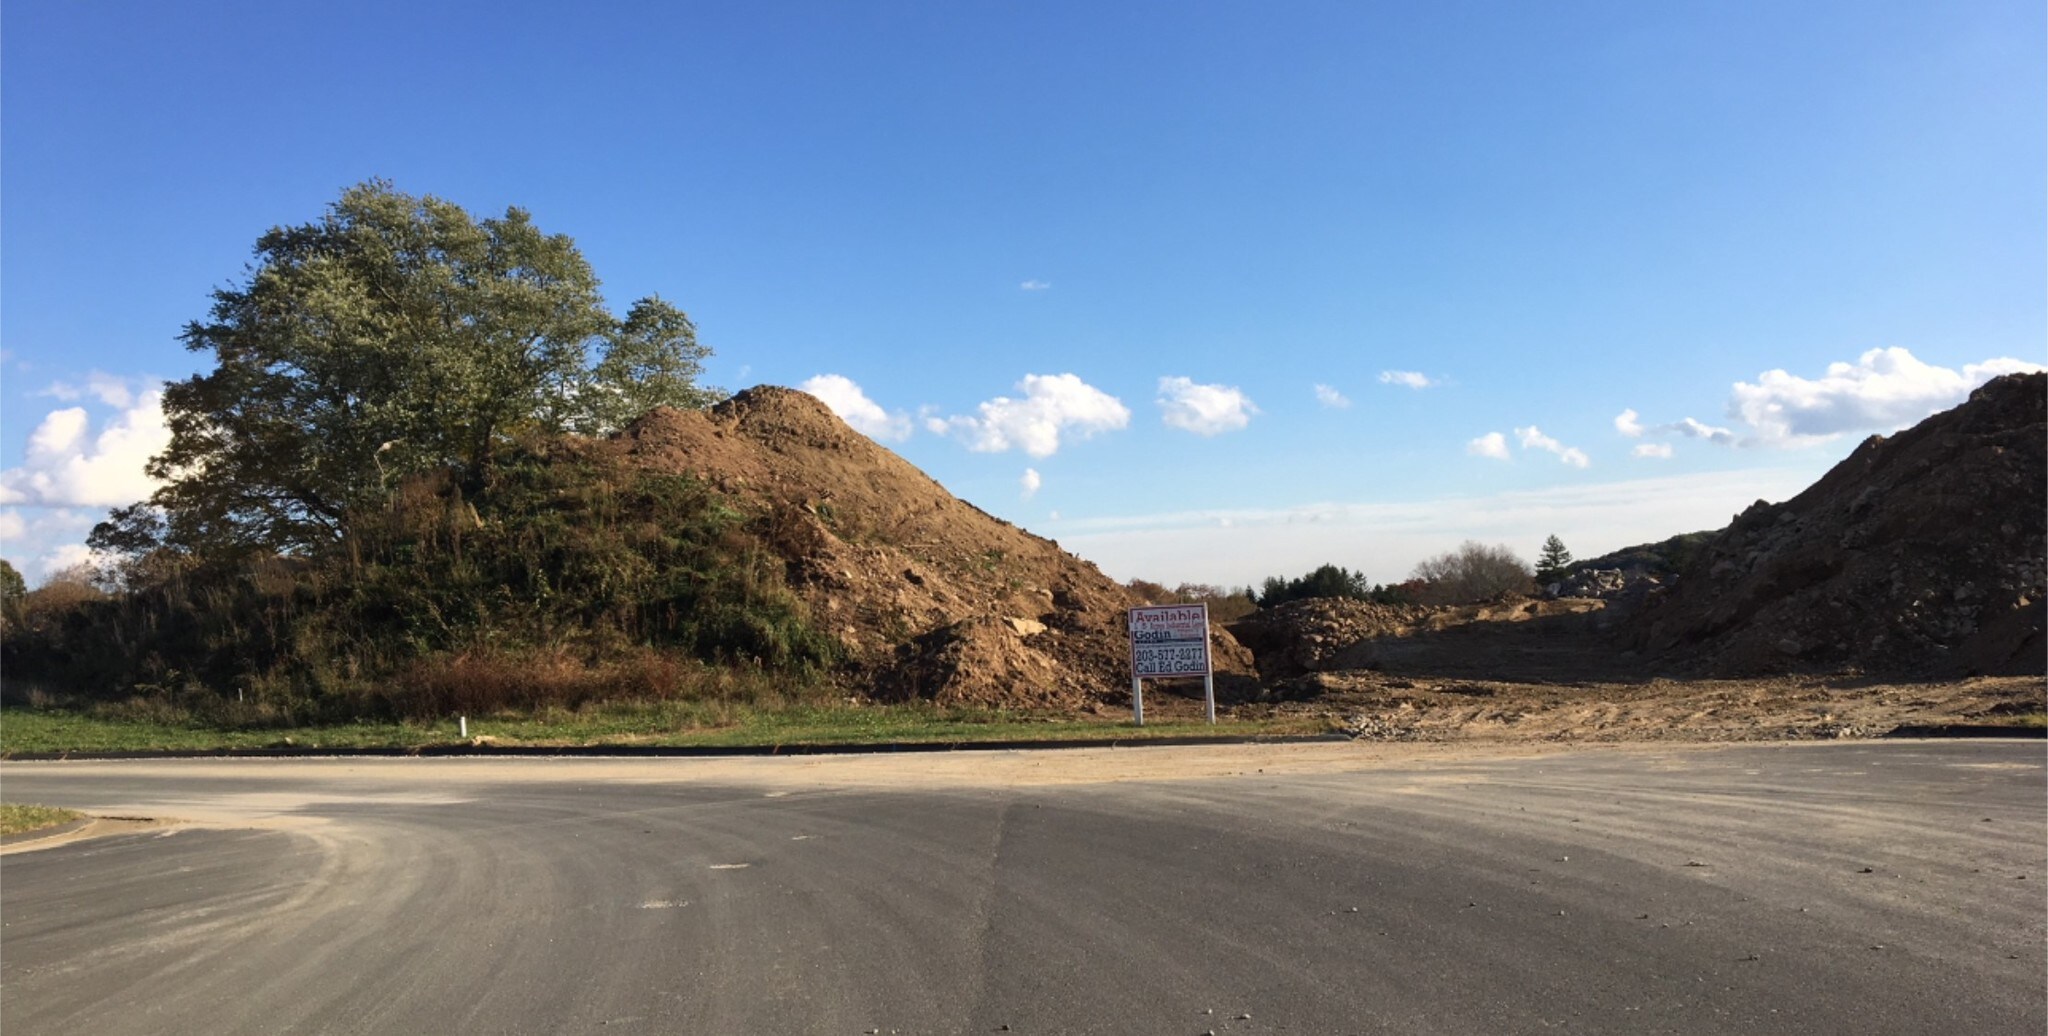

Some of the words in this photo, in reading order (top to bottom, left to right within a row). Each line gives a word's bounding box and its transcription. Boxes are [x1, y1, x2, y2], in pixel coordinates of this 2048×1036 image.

[1136, 610, 1200, 622] Available
[1134, 630, 1171, 640] Godin
[1136, 648, 1203, 661] 203-577-2277
[1136, 662, 1156, 673] Call
[1158, 661, 1172, 672] Ed
[1174, 660, 1205, 672] Godin
